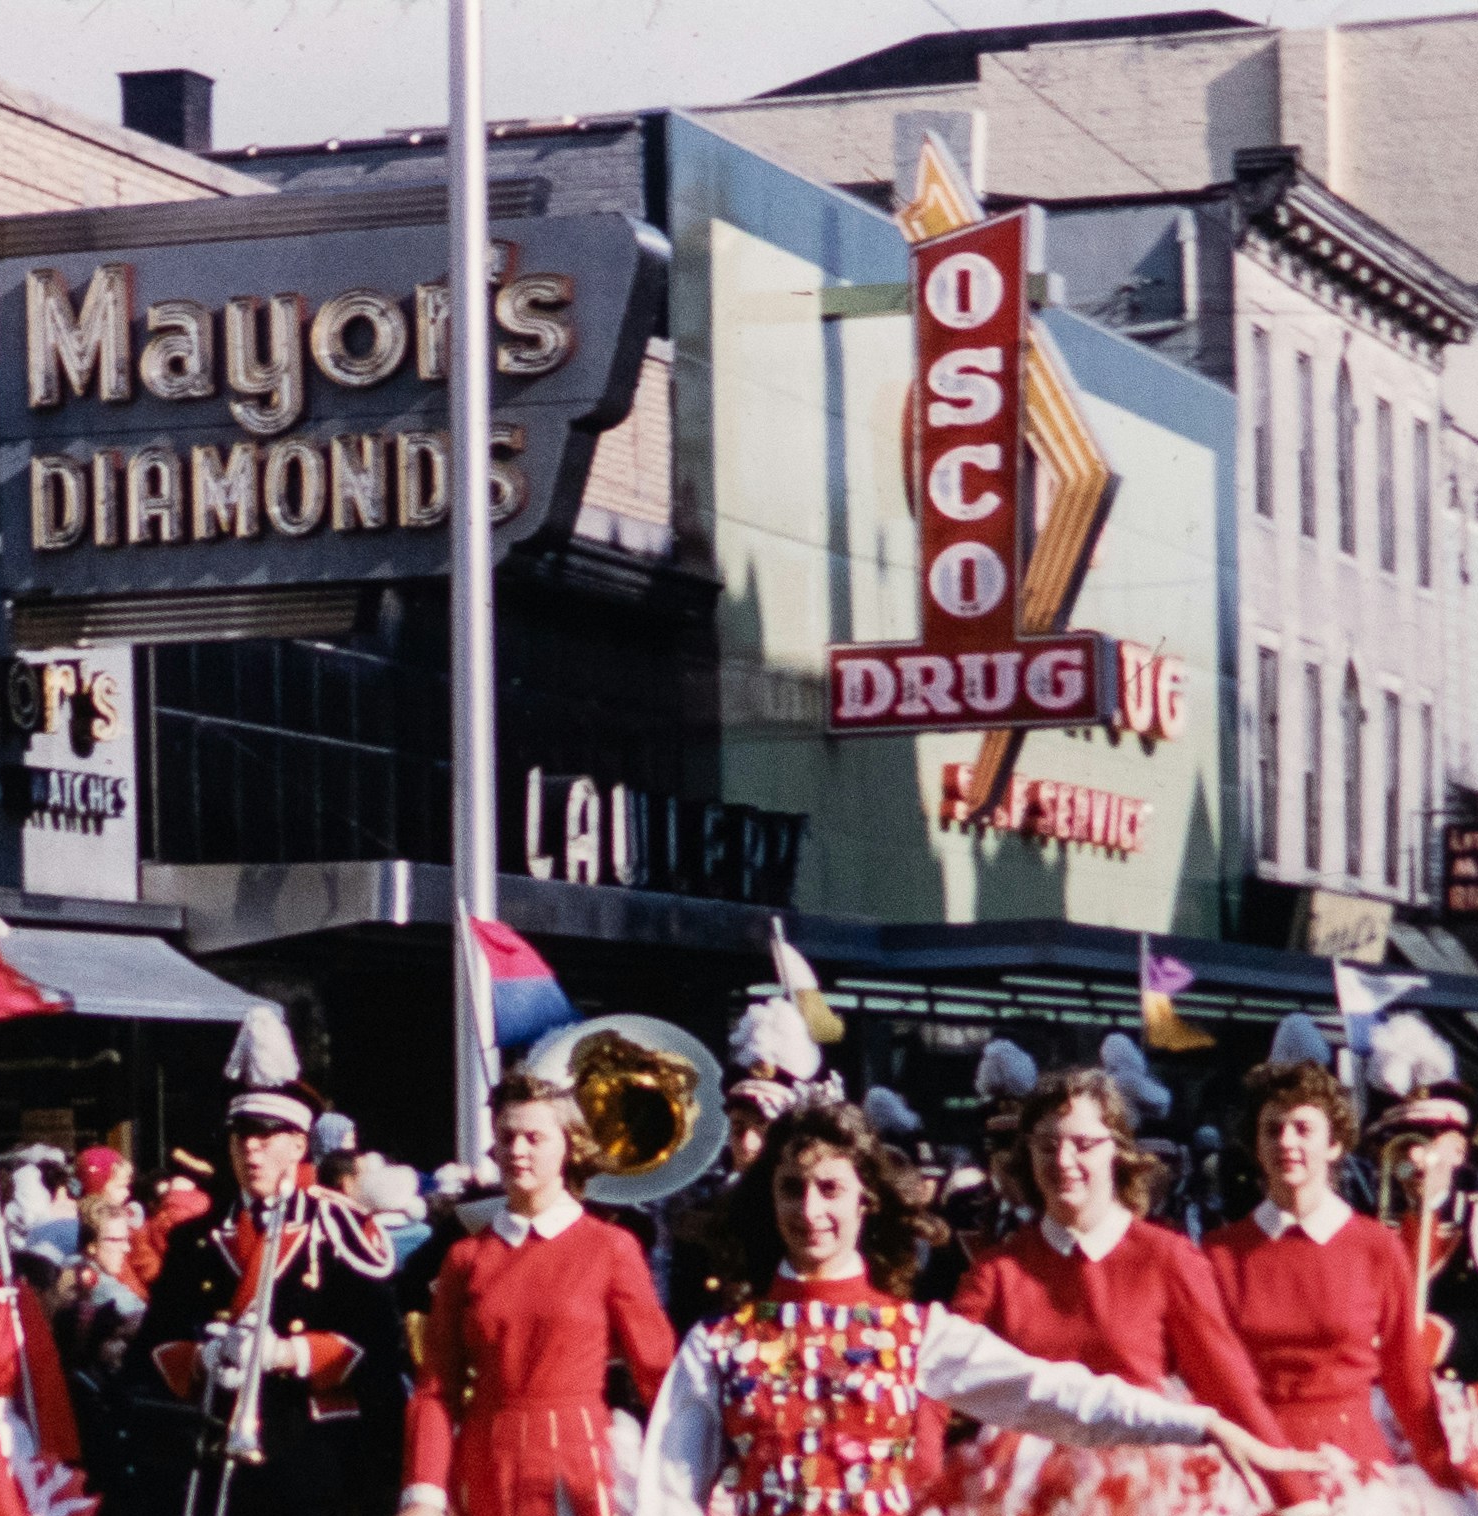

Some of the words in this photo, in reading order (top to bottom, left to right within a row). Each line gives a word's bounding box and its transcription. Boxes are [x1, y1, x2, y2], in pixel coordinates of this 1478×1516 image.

[30, 422, 529, 552] DIAMONDS
[924, 252, 1007, 620] OSCO
[836, 648, 1084, 720] DRUG
